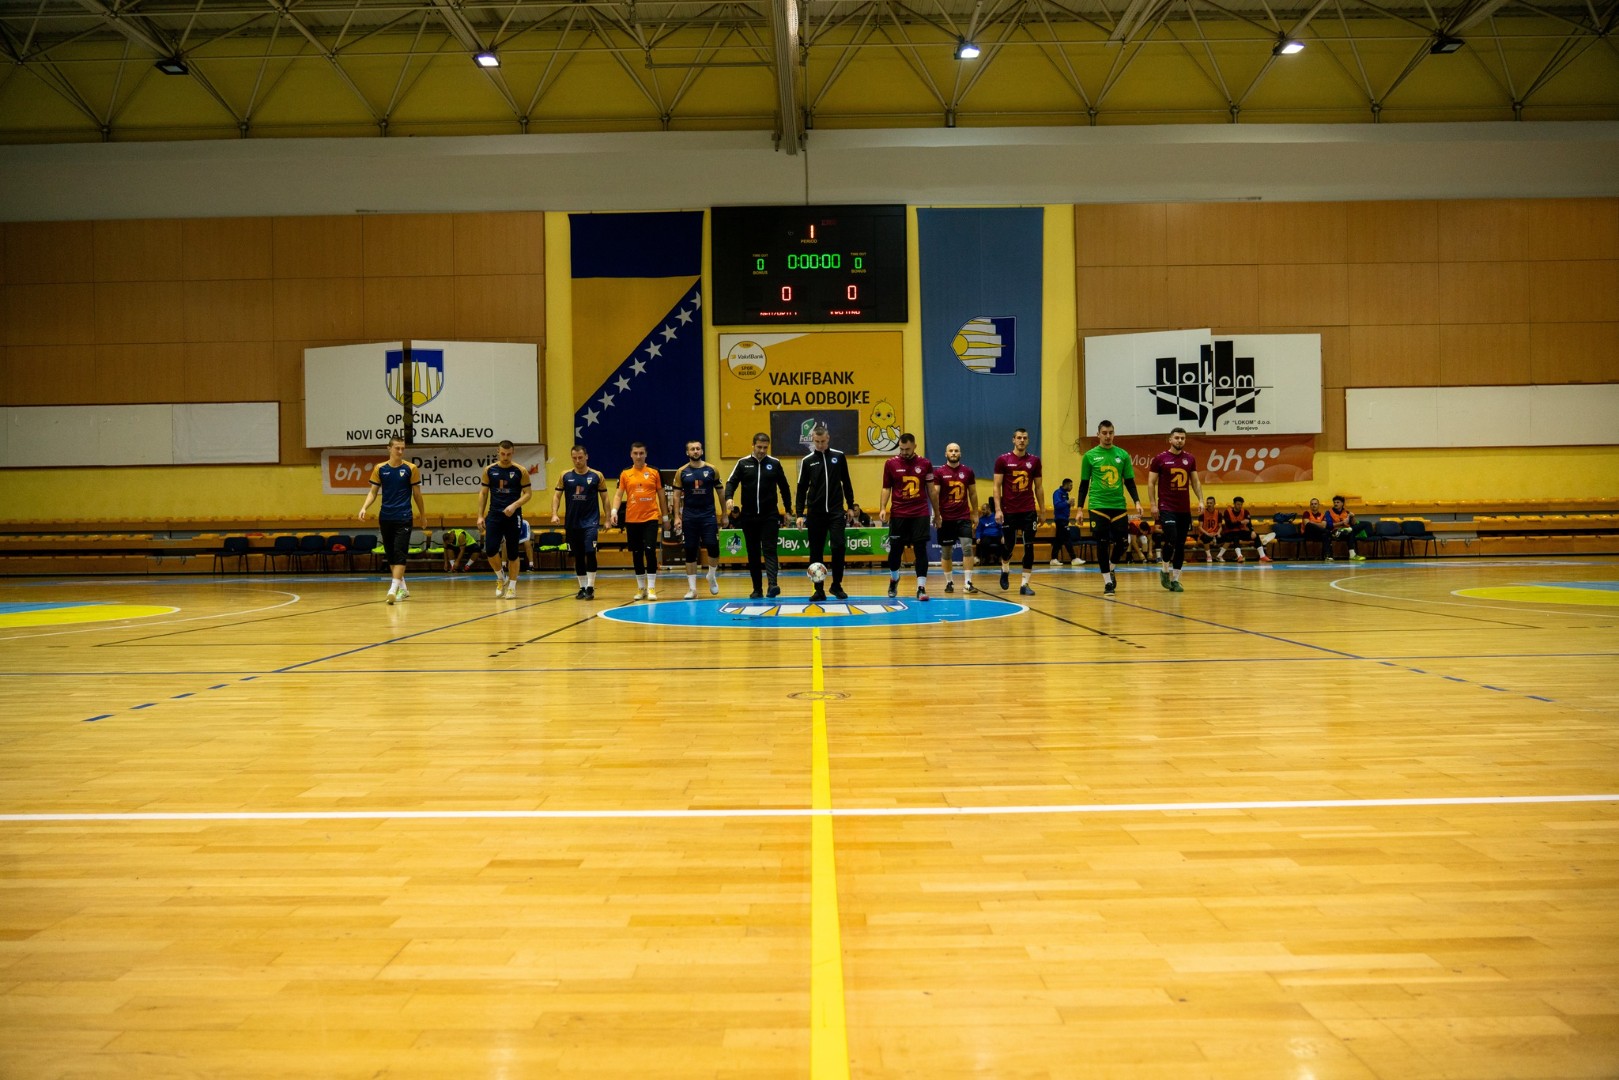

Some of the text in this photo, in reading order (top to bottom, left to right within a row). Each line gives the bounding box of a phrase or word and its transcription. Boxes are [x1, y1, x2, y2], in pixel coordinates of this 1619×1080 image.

[810, 224, 815, 239] 1
[756, 258, 765, 271] 0
[787, 254, 841, 269] 0:00:00
[854, 257, 863, 269] 0
[781, 286, 792, 301] 0
[847, 285, 857, 300] 0
[769, 371, 855, 386] VAKIFBANK
[754, 389, 870, 408] ŠKOLA ODBOJKE
[386, 410, 444, 425] OPĆINA
[346, 429, 373, 441] NOVI
[421, 427, 494, 438] SARAJEVO
[411, 456, 472, 472] Dajemo
[1130, 454, 1152, 469] Moj
[1207, 448, 1242, 472] bh
[335, 462, 362, 481] bh
[435, 473, 482, 486] Teleco
[777, 536, 800, 550] Play,
[847, 536, 872, 550] igre!
